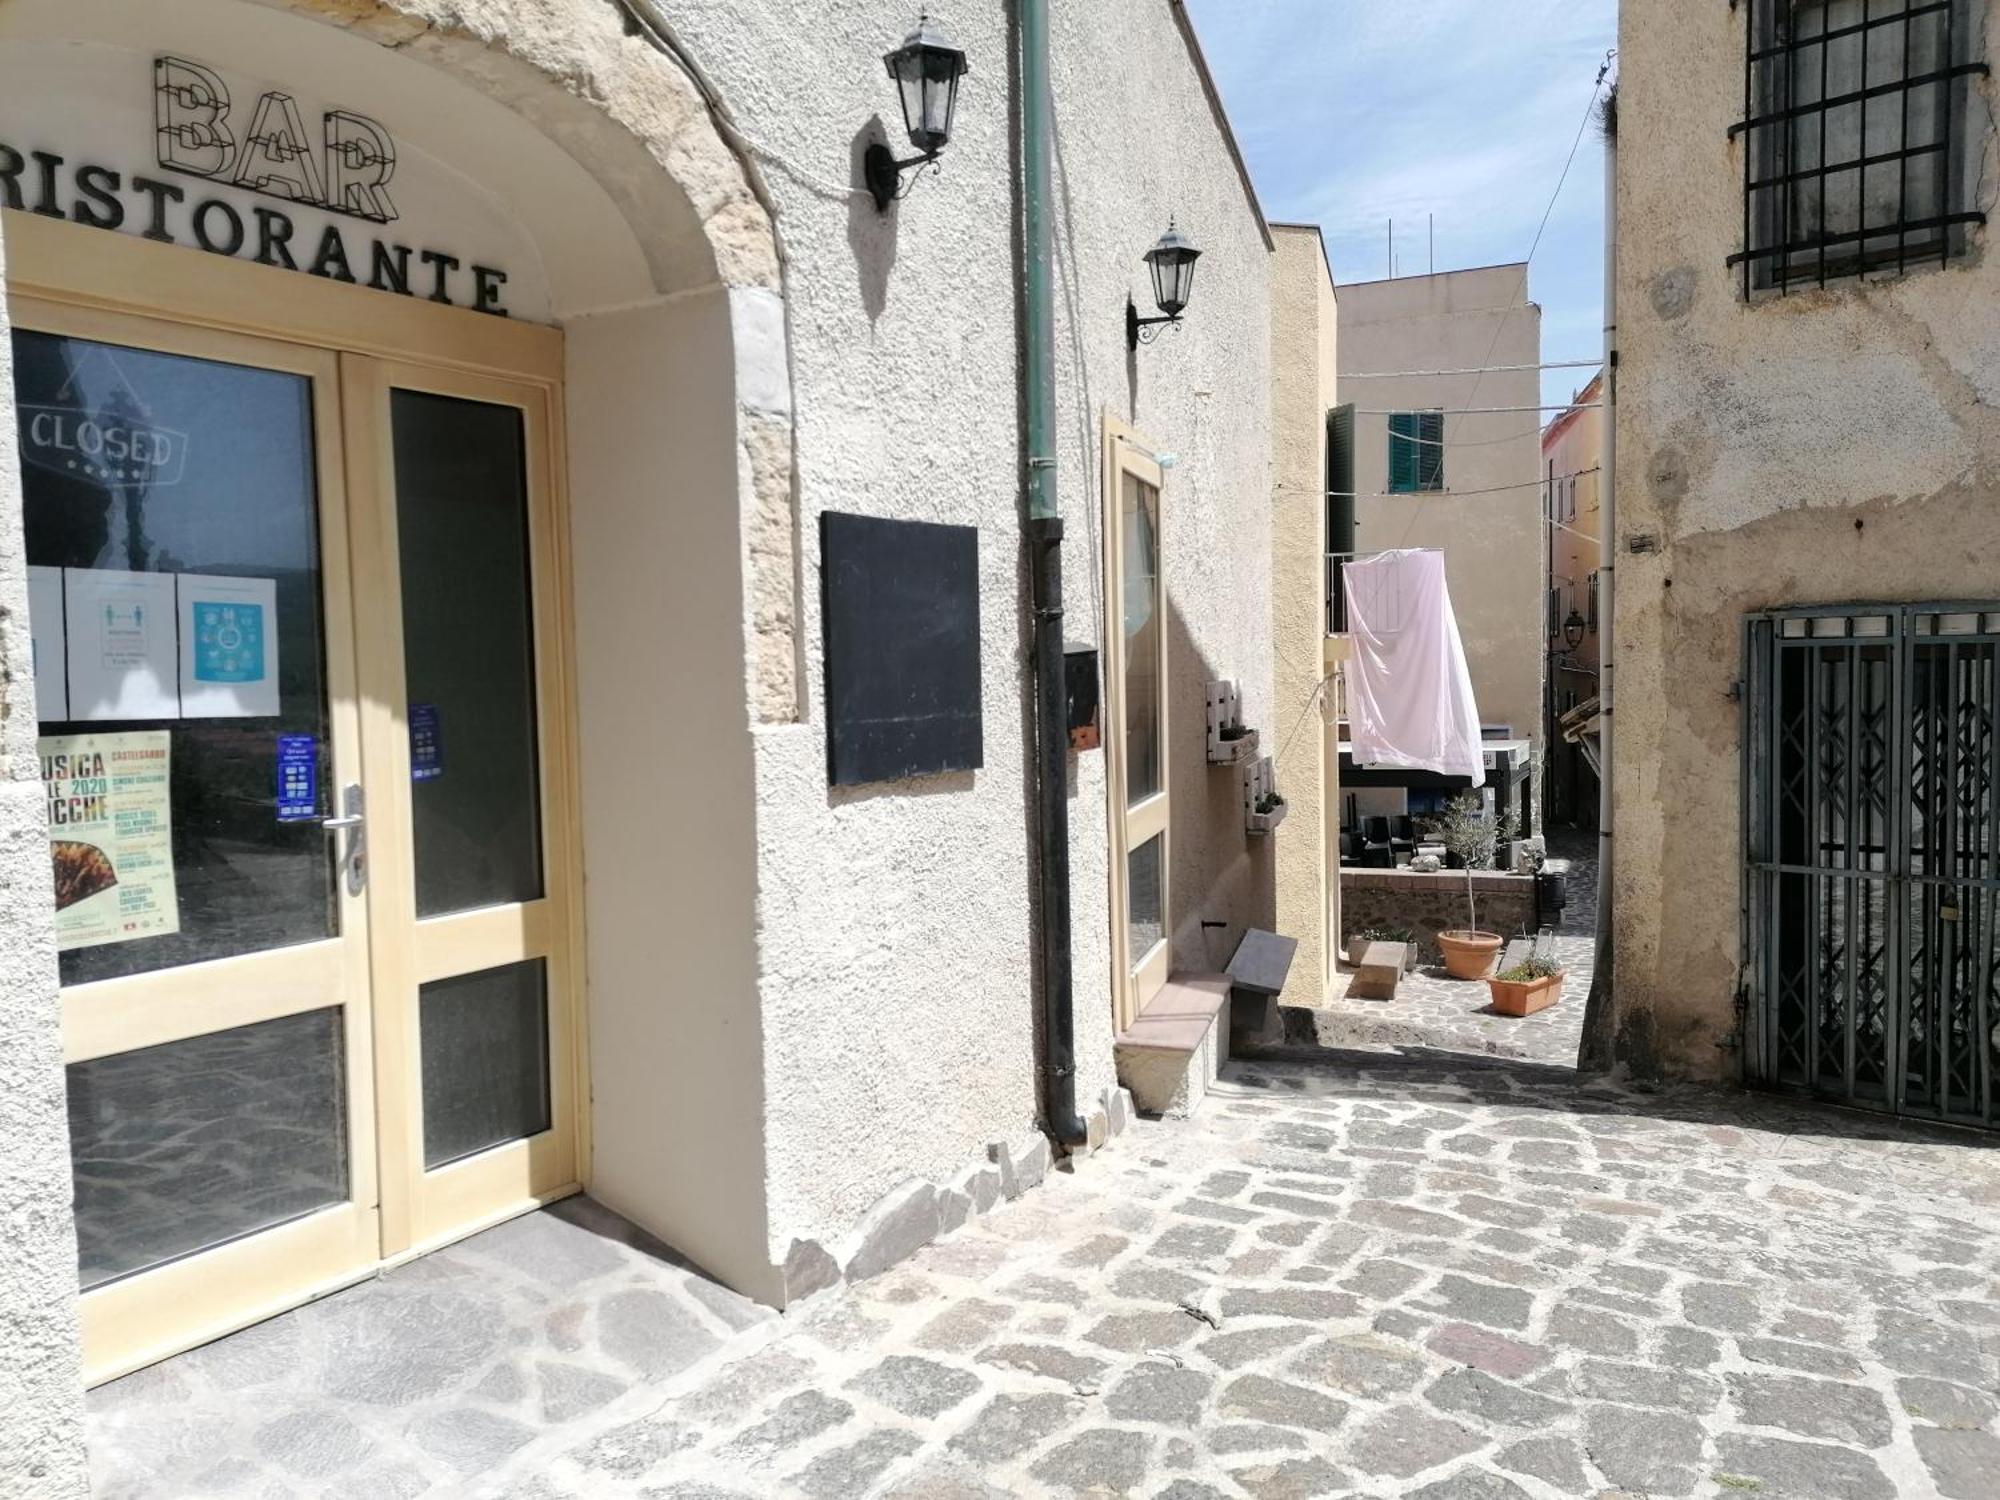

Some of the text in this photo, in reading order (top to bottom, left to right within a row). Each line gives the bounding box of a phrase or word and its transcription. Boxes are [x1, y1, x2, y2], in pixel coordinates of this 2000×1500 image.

[154, 55, 399, 224] BAR
[31, 412, 172, 466] CLOSED
[40, 752, 106, 781] USICA
[72, 778, 108, 796] 2020
